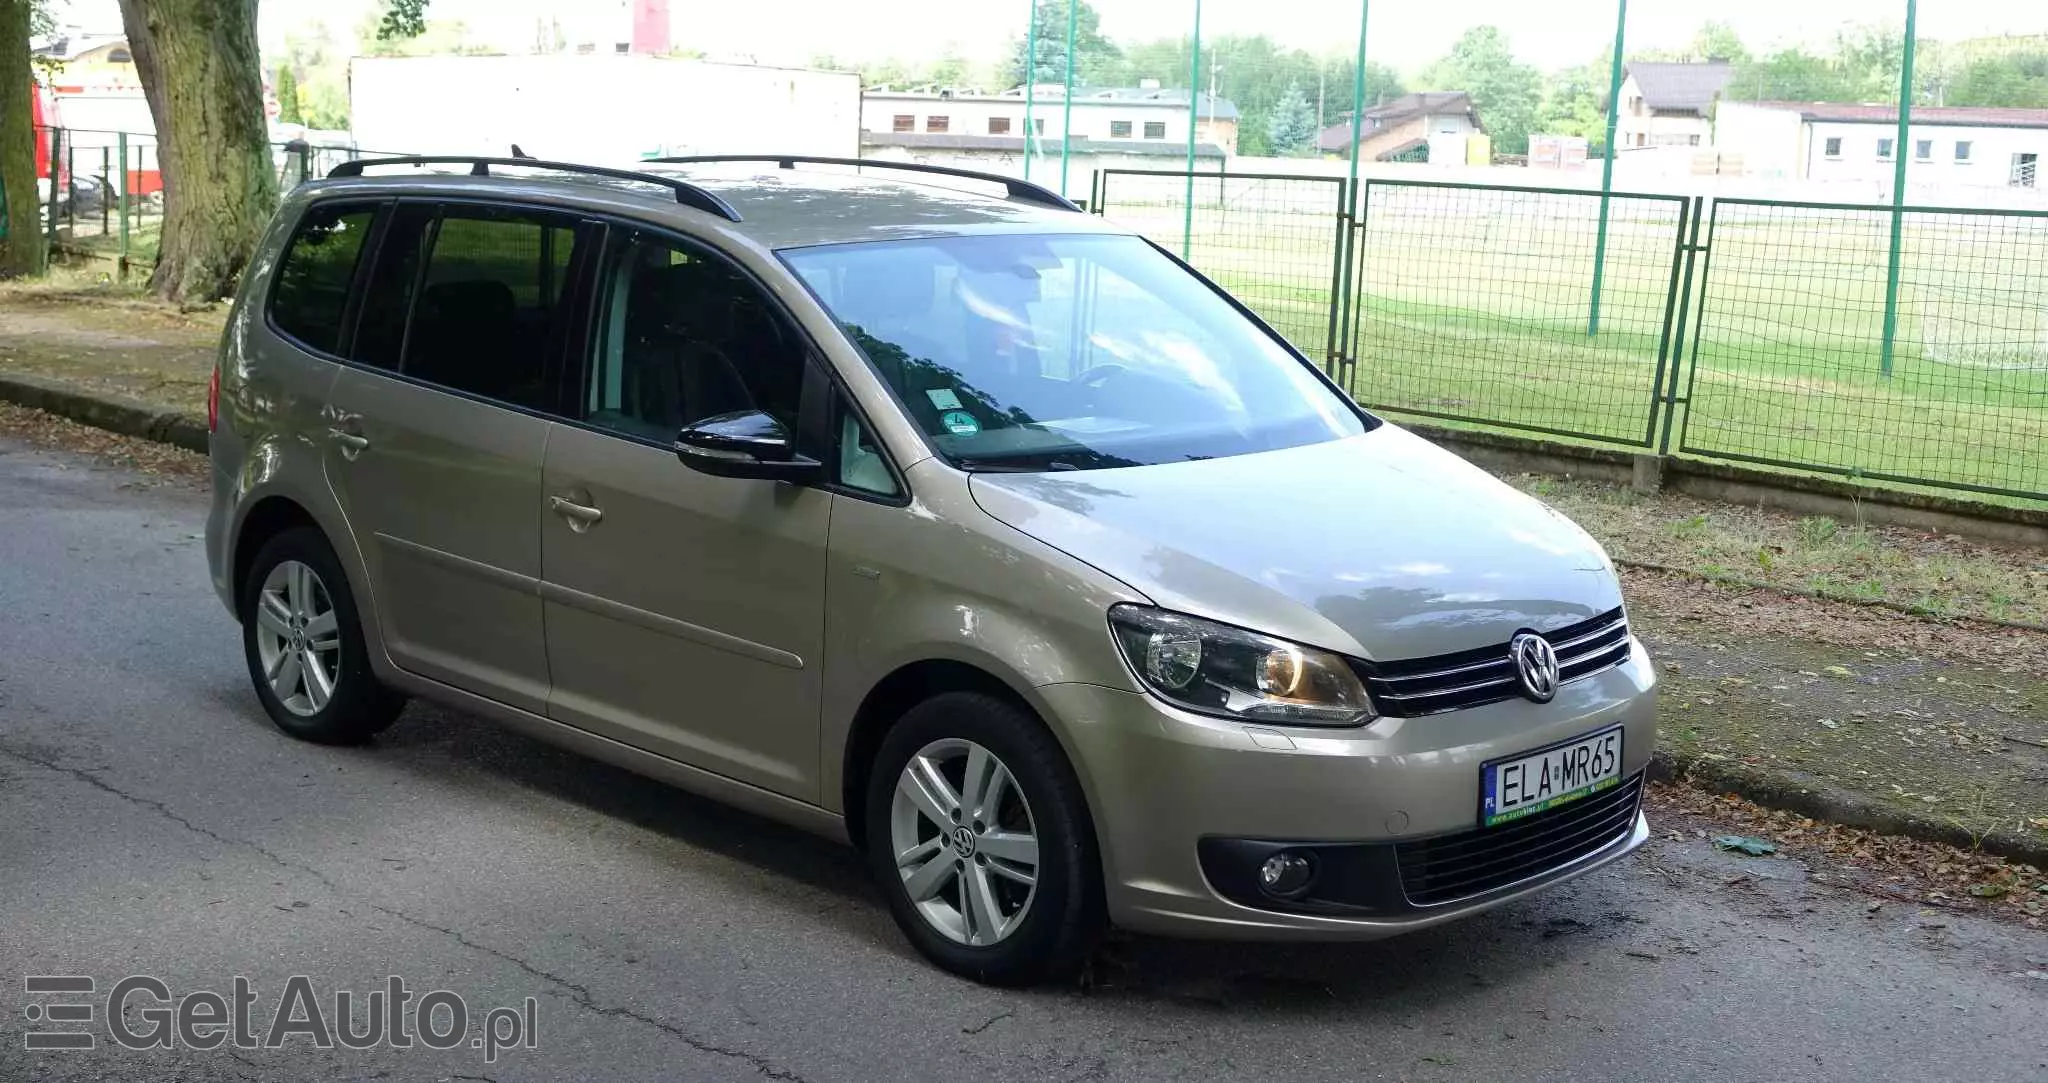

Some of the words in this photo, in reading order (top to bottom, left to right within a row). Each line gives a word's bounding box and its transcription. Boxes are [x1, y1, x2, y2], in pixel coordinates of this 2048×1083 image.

[1503, 757, 1552, 808] ELA
[1562, 736, 1616, 791] MR65
[1485, 797, 1495, 809] PL
